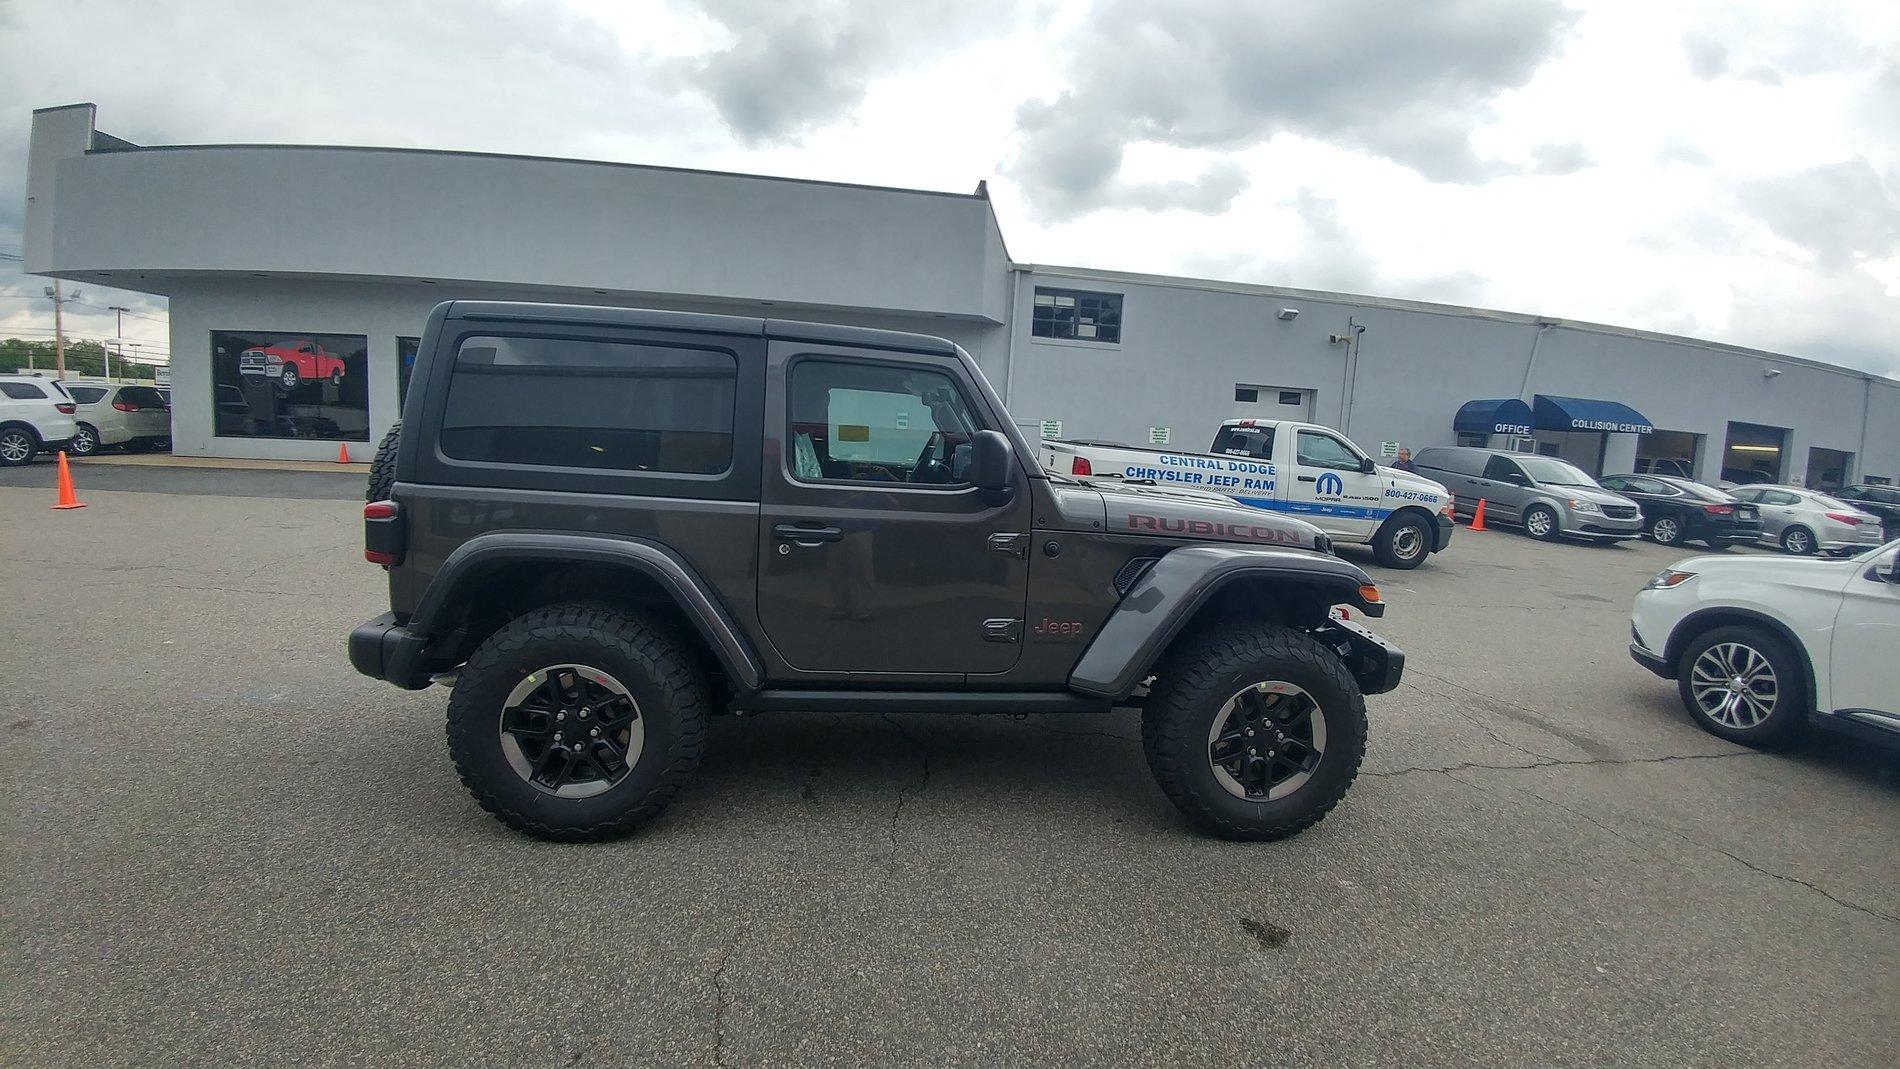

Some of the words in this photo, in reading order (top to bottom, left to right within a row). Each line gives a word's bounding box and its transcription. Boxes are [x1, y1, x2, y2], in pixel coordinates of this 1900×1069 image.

[1494, 423, 1530, 435] OFFICE
[1571, 419, 1618, 431] COLLISION
[1619, 423, 1653, 434] CENTER
[1159, 455, 1224, 471] CENTRAL
[1228, 461, 1276, 476] DODGE
[1125, 466, 1203, 484] CHRYSLER
[1206, 474, 1240, 487] JEEP
[1244, 478, 1275, 491] RAM
[1212, 486, 1236, 494] PARTS
[1238, 488, 1273, 496] DELIVERY
[1385, 489, 1438, 504] 800-427-0666
[1128, 513, 1301, 543] RUBICON
[1034, 618, 1082, 638] Jeep
